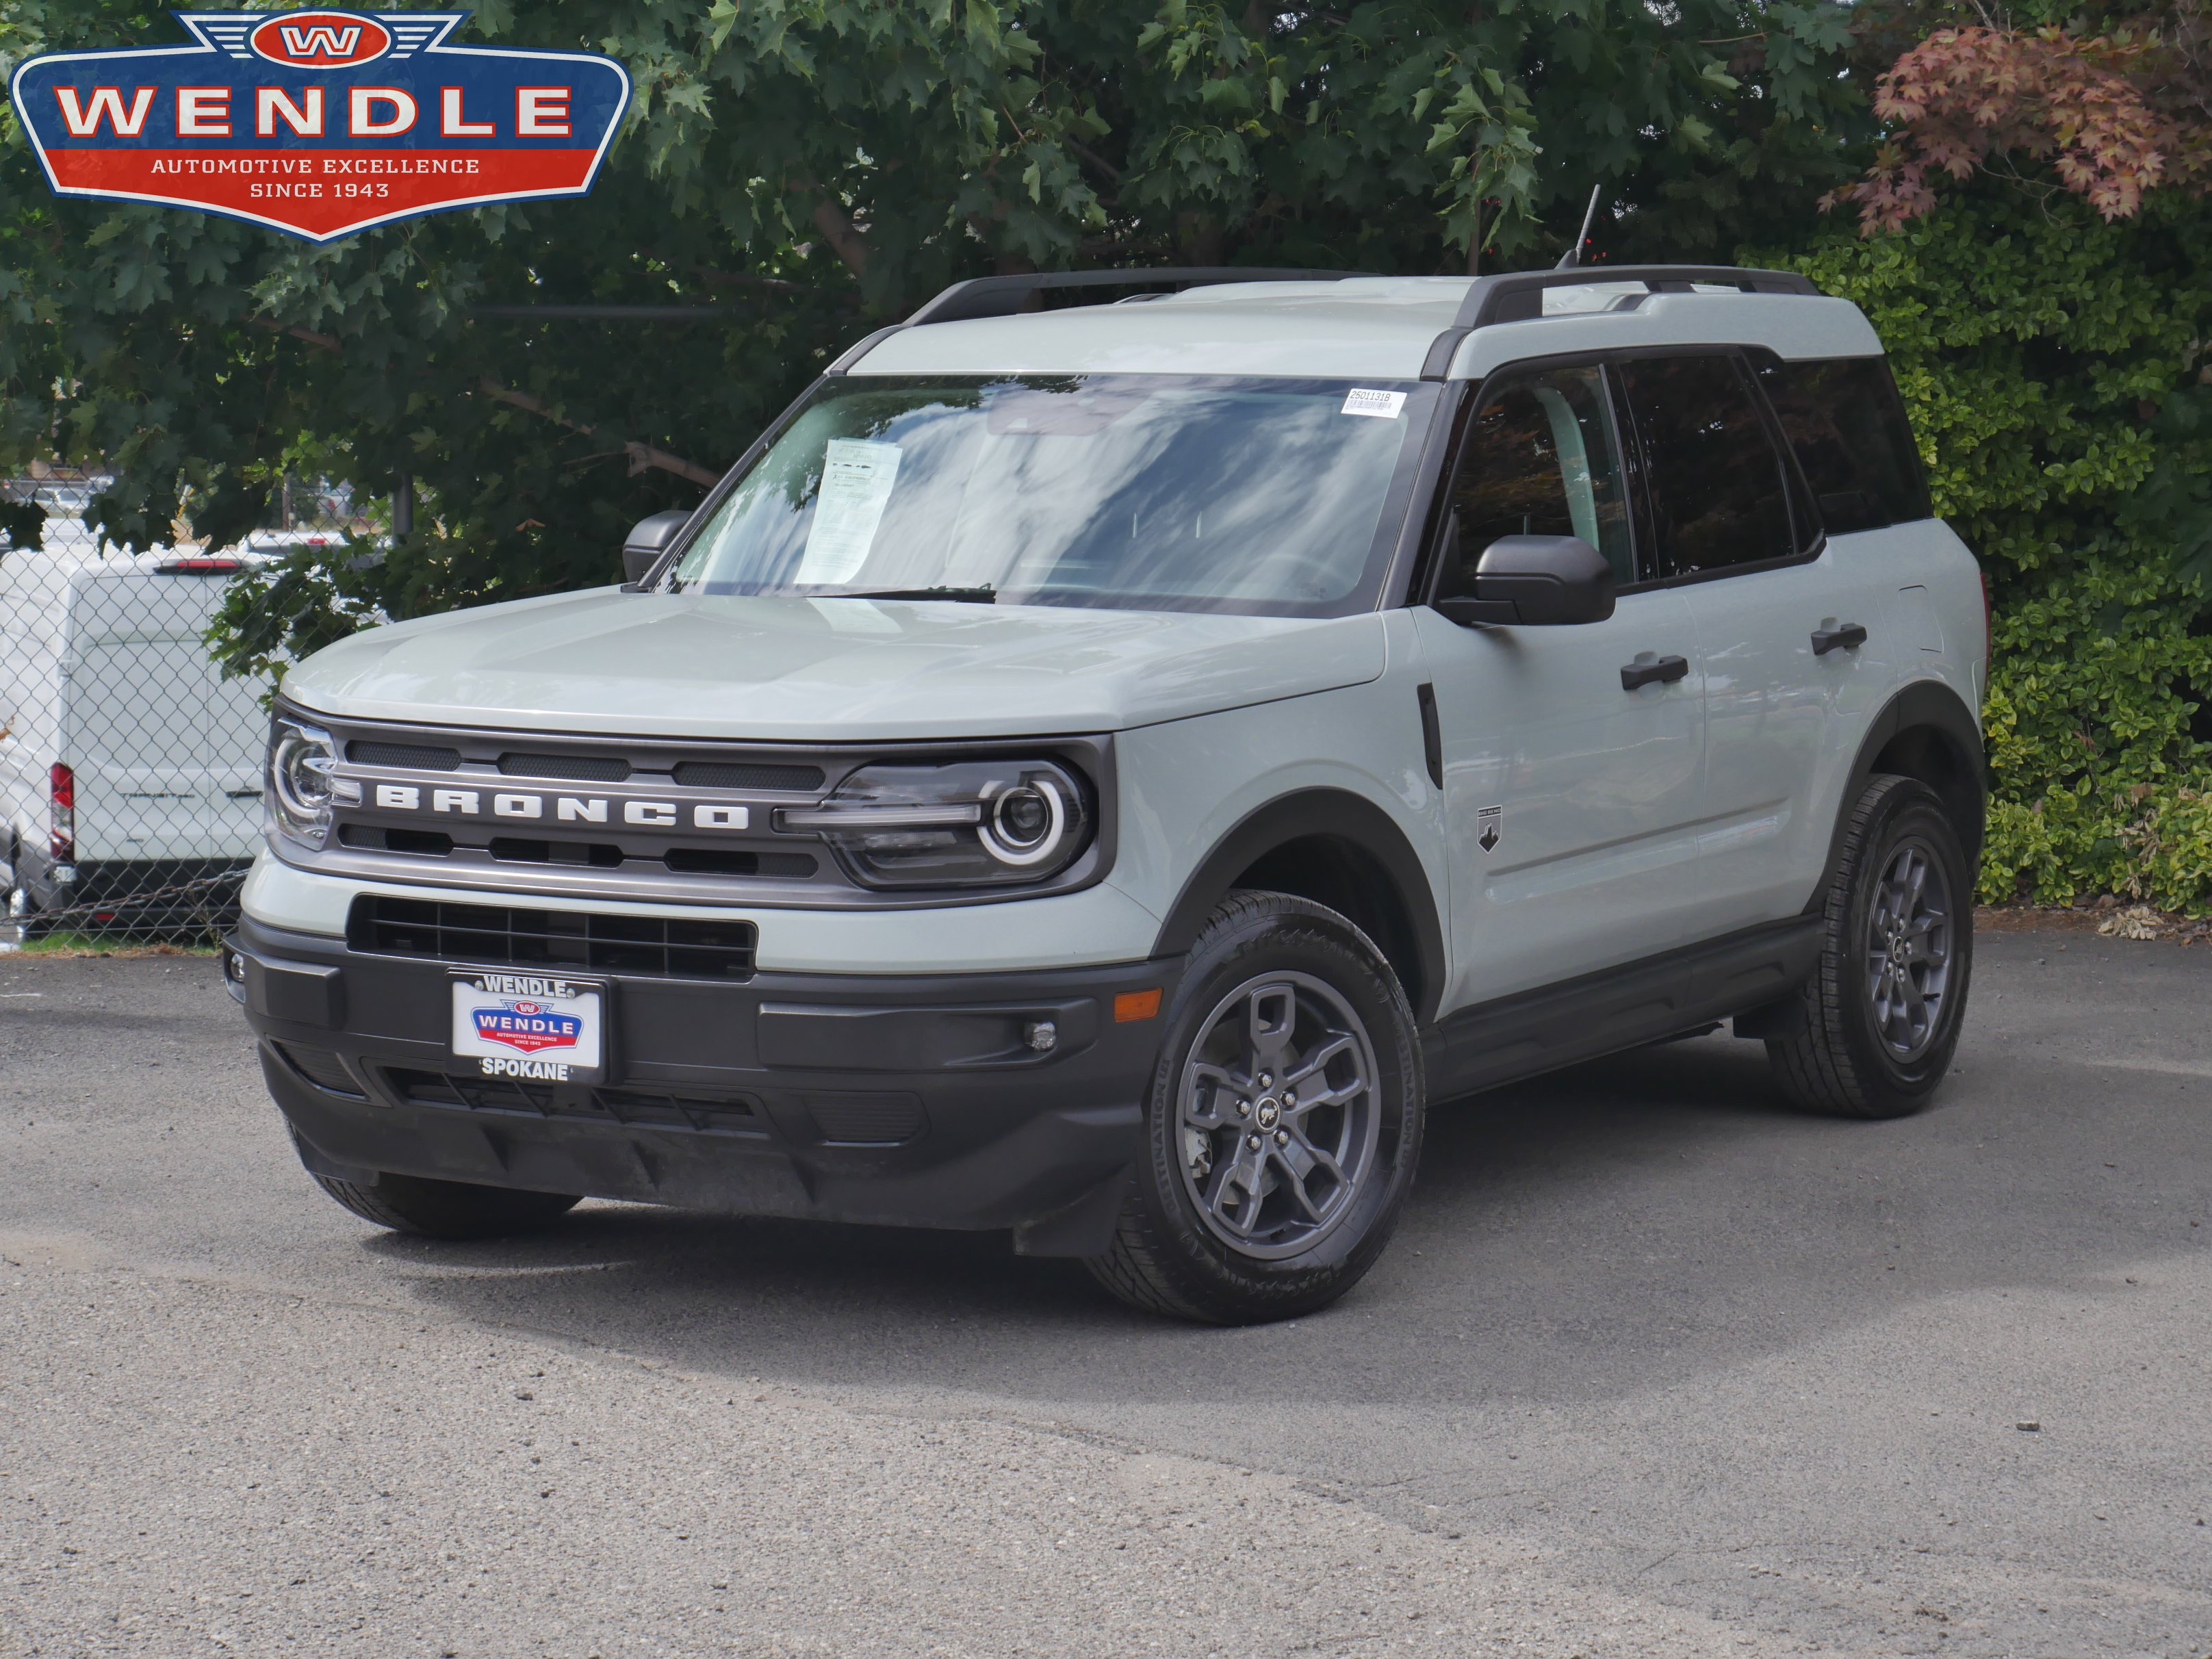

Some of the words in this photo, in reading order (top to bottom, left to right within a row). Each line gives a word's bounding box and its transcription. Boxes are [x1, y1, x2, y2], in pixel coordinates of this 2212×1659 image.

[1350, 391, 1391, 402] 2501131B
[376, 785, 749, 830] BRONCO
[483, 975, 567, 998] WENDLE
[478, 1014, 574, 1035] WENDLE
[482, 1057, 568, 1081] SPOKANE
